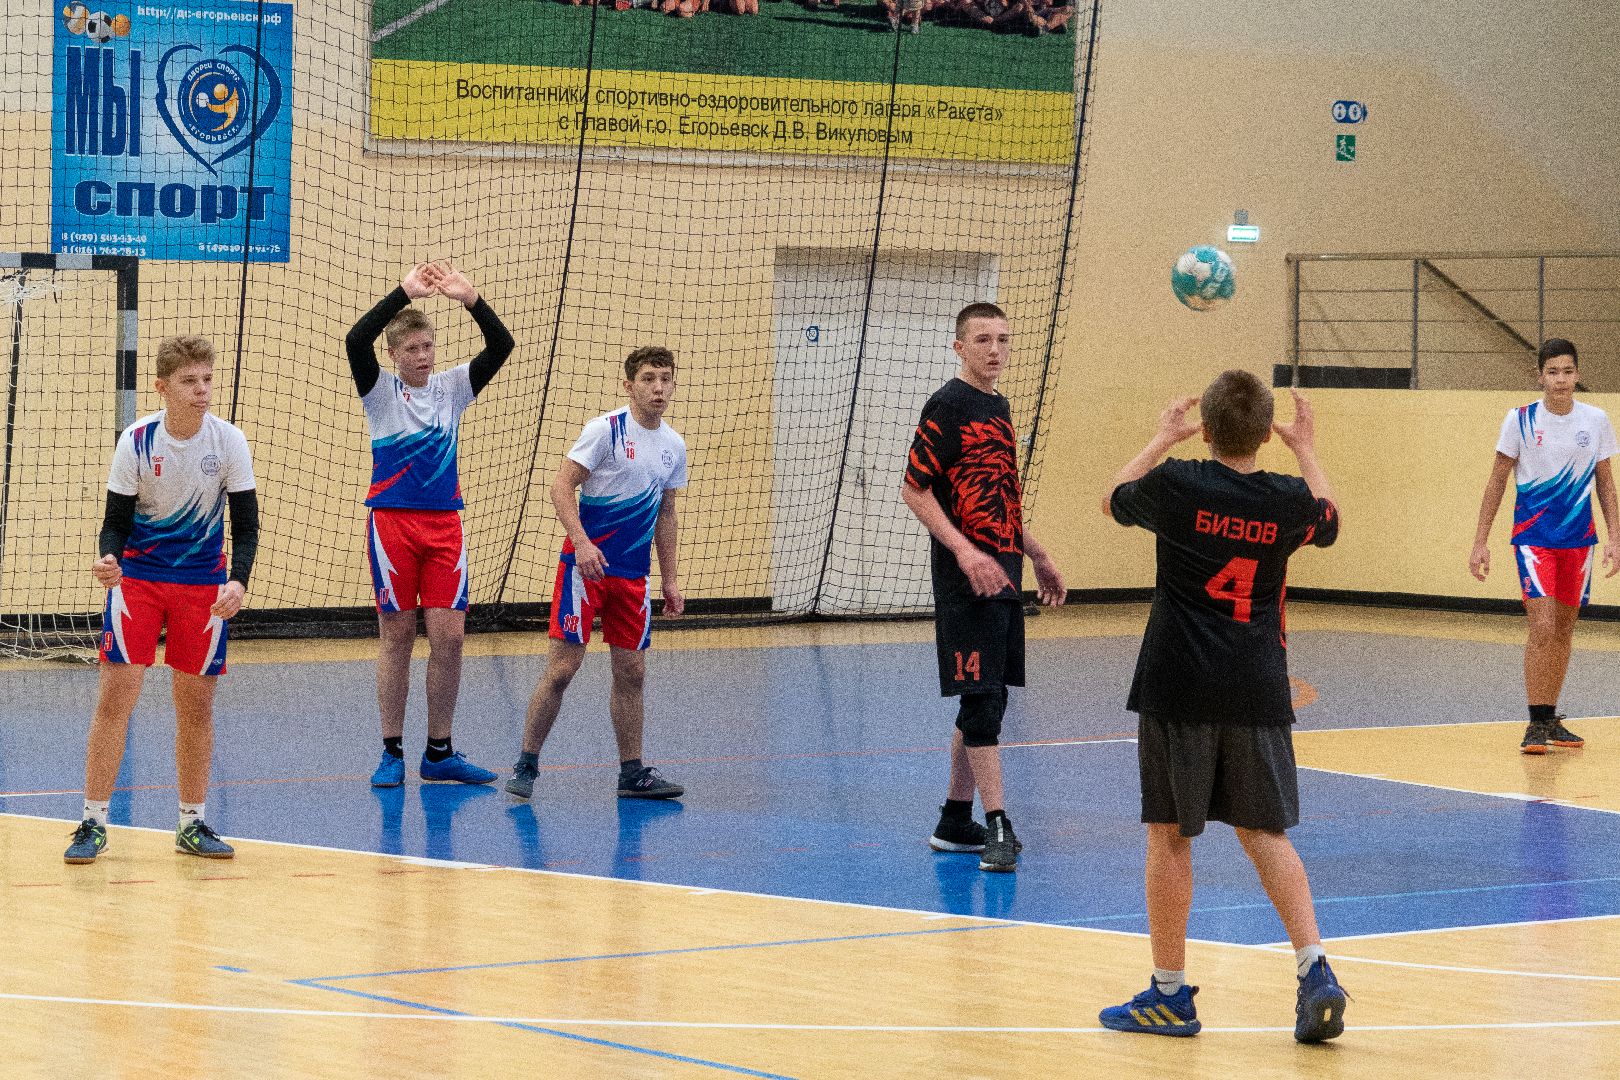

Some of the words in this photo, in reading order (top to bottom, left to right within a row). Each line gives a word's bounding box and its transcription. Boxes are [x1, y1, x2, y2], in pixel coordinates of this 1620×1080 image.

[65, 46, 141, 157] МЫ
[456, 78, 588, 103] Воспитанники
[596, 89, 858, 116] спортивно-оздоровительного
[864, 101, 921, 121] лагеря
[927, 100, 1003, 121] «Ракета»
[559, 116, 569, 129] с
[576, 112, 640, 133] Главой
[680, 116, 769, 140] Егорьевск
[816, 122, 913, 146] Викуловым
[74, 180, 275, 223] спорт
[154, 463, 161, 477] 9
[625, 447, 635, 460] 18
[1195, 510, 1278, 545] БИЗОВ
[1204, 556, 1259, 623] 4
[563, 613, 580, 634] 18
[104, 631, 113, 652] 9
[954, 651, 981, 681] 14
